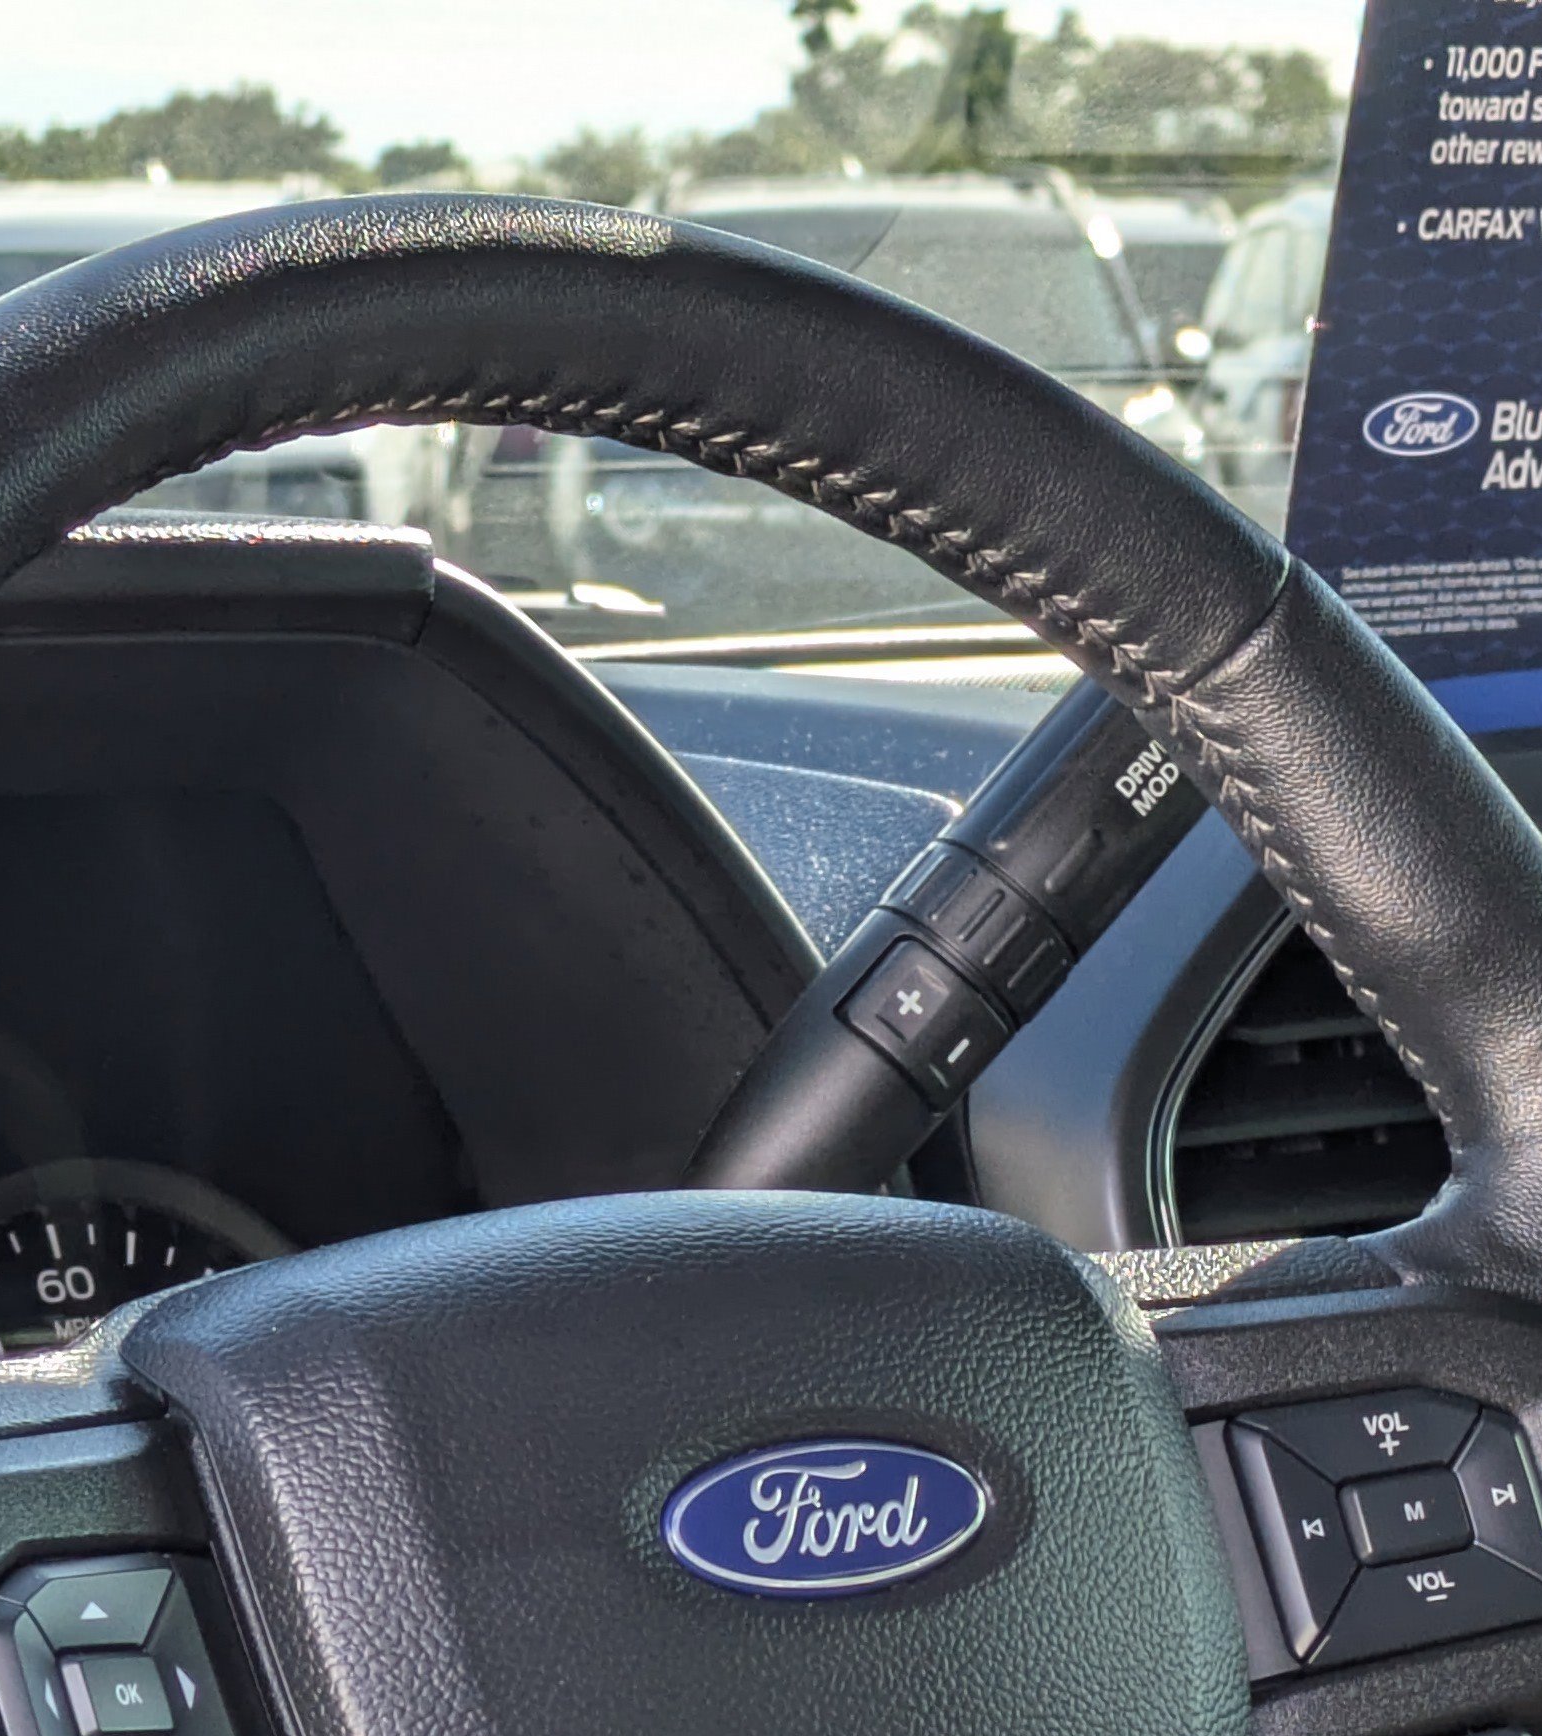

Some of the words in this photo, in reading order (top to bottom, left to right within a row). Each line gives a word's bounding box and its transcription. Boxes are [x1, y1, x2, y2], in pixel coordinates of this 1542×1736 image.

[1446, 46, 1524, 83] 11,000
[1439, 90, 1530, 122] toward
[1430, 134, 1501, 165] other
[1383, 401, 1458, 446] Ford
[1131, 761, 1179, 817] MOD
[36, 1265, 95, 1304] 60
[1363, 1412, 1409, 1436] VOL
[743, 1460, 928, 1565] Ford
[1404, 1501, 1424, 1522] M
[1407, 1570, 1455, 1593] VOL
[115, 1683, 143, 1706] OK
